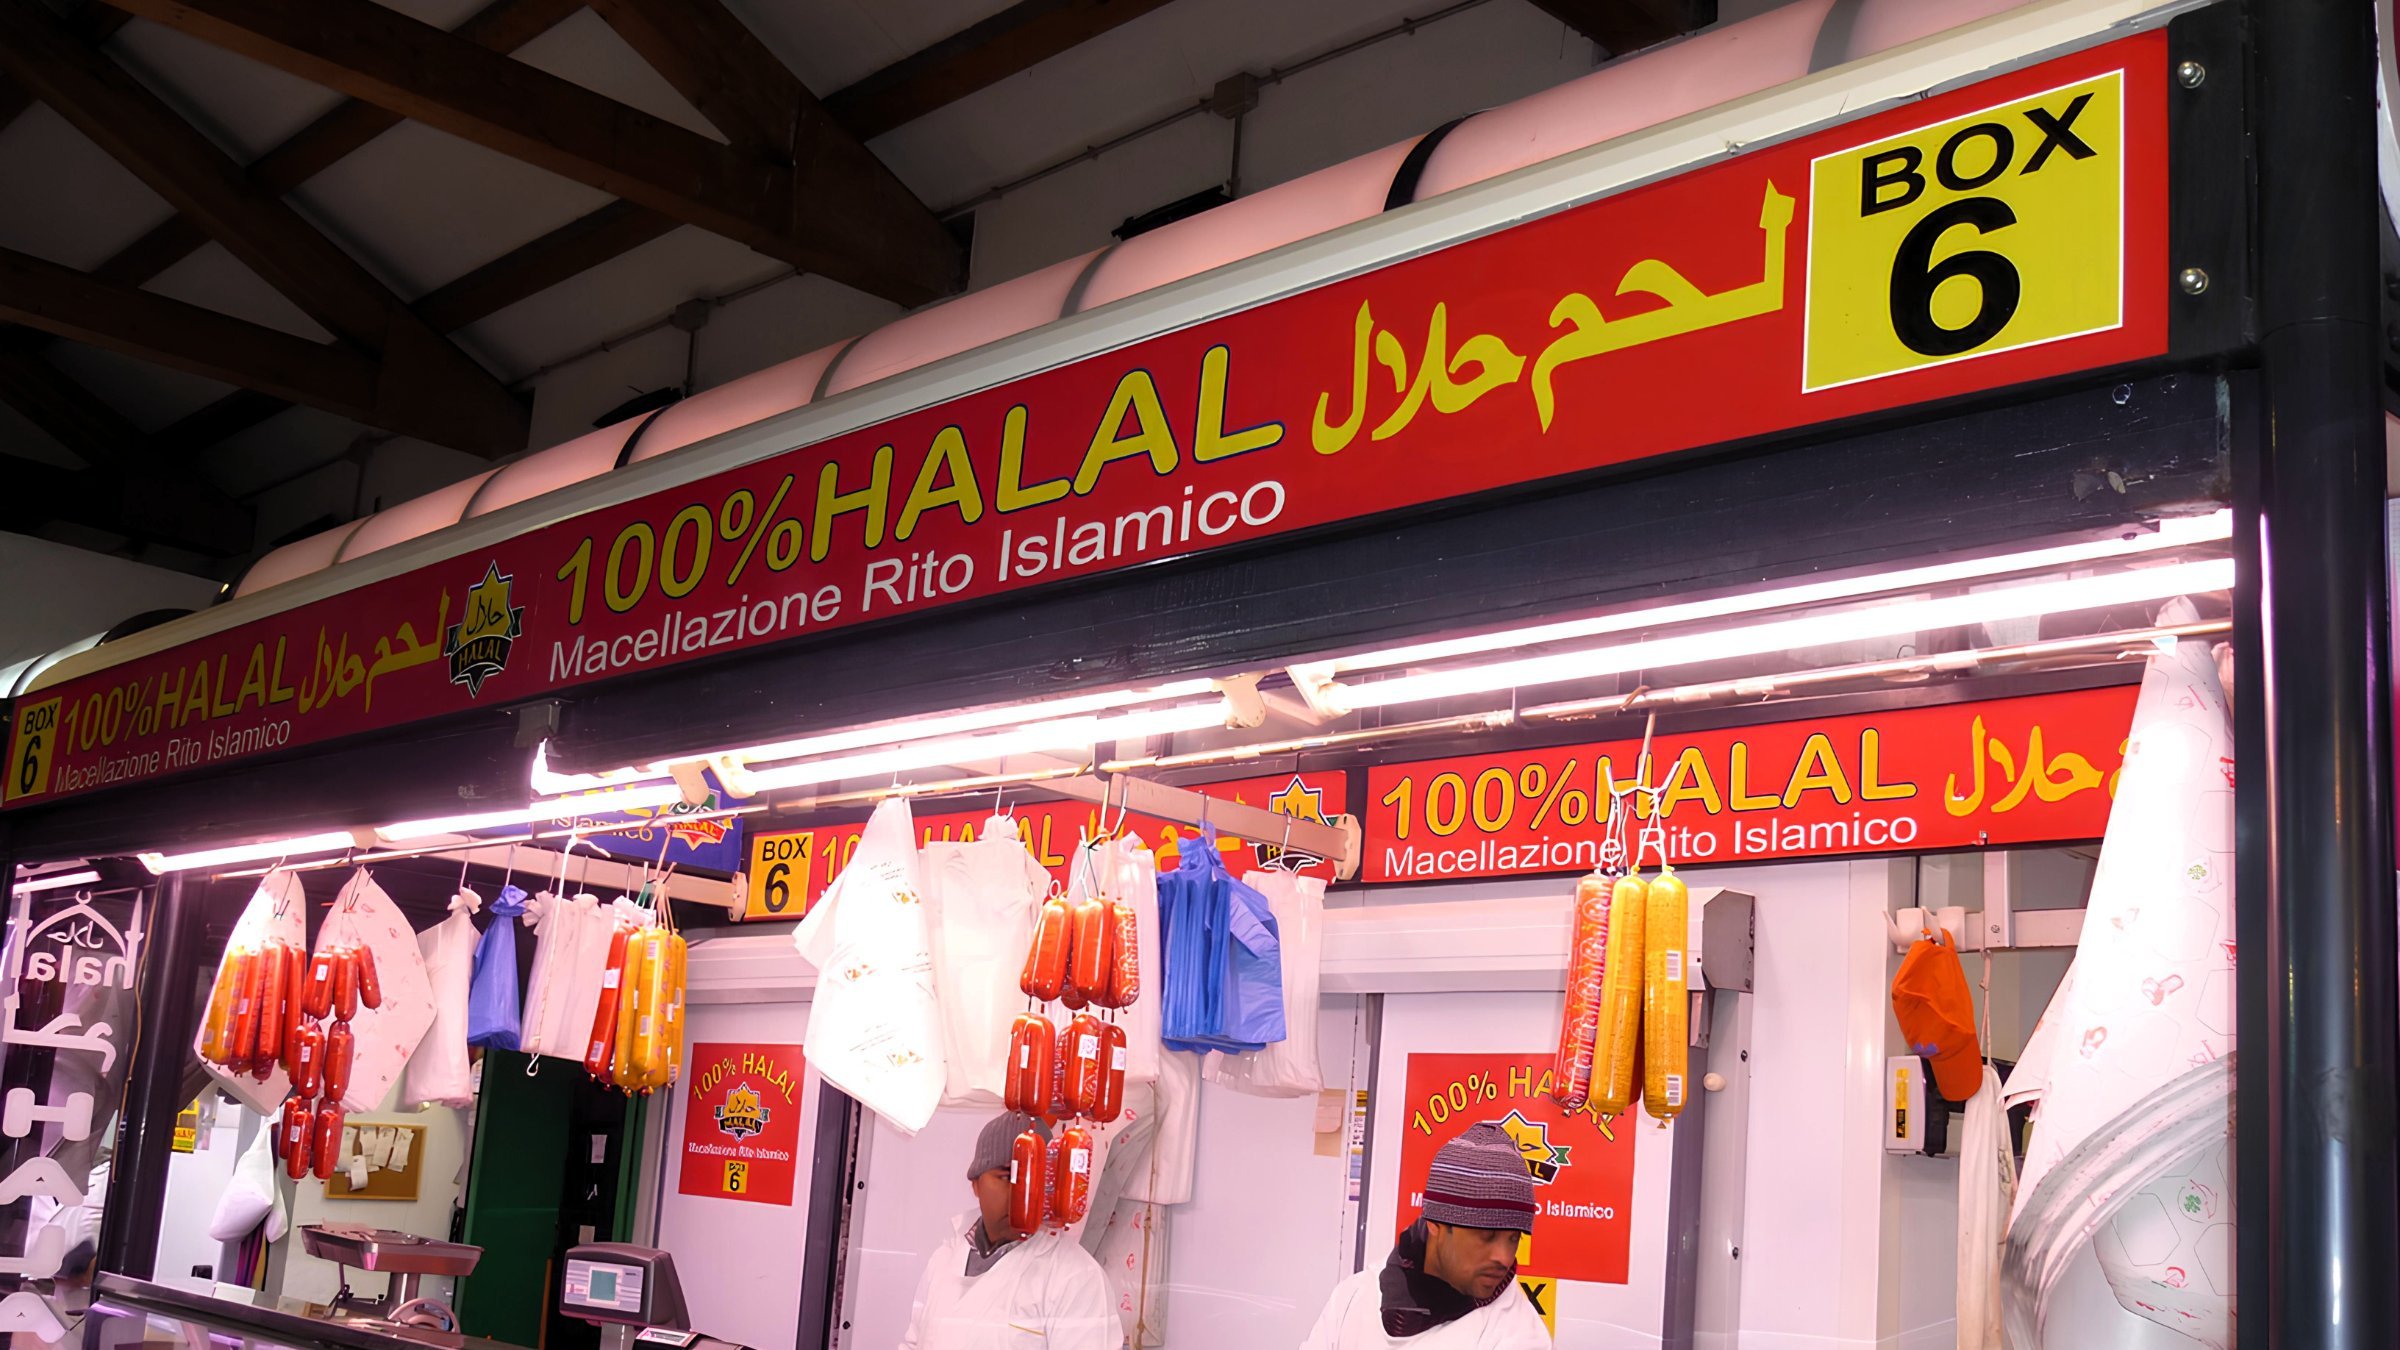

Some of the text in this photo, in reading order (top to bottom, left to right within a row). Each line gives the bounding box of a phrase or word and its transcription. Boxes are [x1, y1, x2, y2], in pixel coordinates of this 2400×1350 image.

[1860, 93, 2098, 217] BOX
[1889, 197, 2021, 357] 6
[1311, 178, 1796, 455] لحم حلال
[549, 481, 1286, 683] Macellazione Rito Islamico
[298, 585, 450, 714] لحم حلال
[458, 639, 502, 672] HALAL
[24, 703, 58, 735] BOX
[20, 735, 41, 794] 6
[55, 717, 291, 793] Macellazione Rito Islamico
[1944, 714, 2105, 817] حلال
[762, 837, 808, 861] BOX
[1384, 811, 1918, 877] Macellazione Rito Islamico
[764, 863, 790, 913] 6
[693, 1052, 797, 1105] 100% HALAL
[1412, 1070, 1498, 1136] 100%
[729, 1171, 740, 1191] 6
[1546, 1200, 1614, 1220] Islamico
